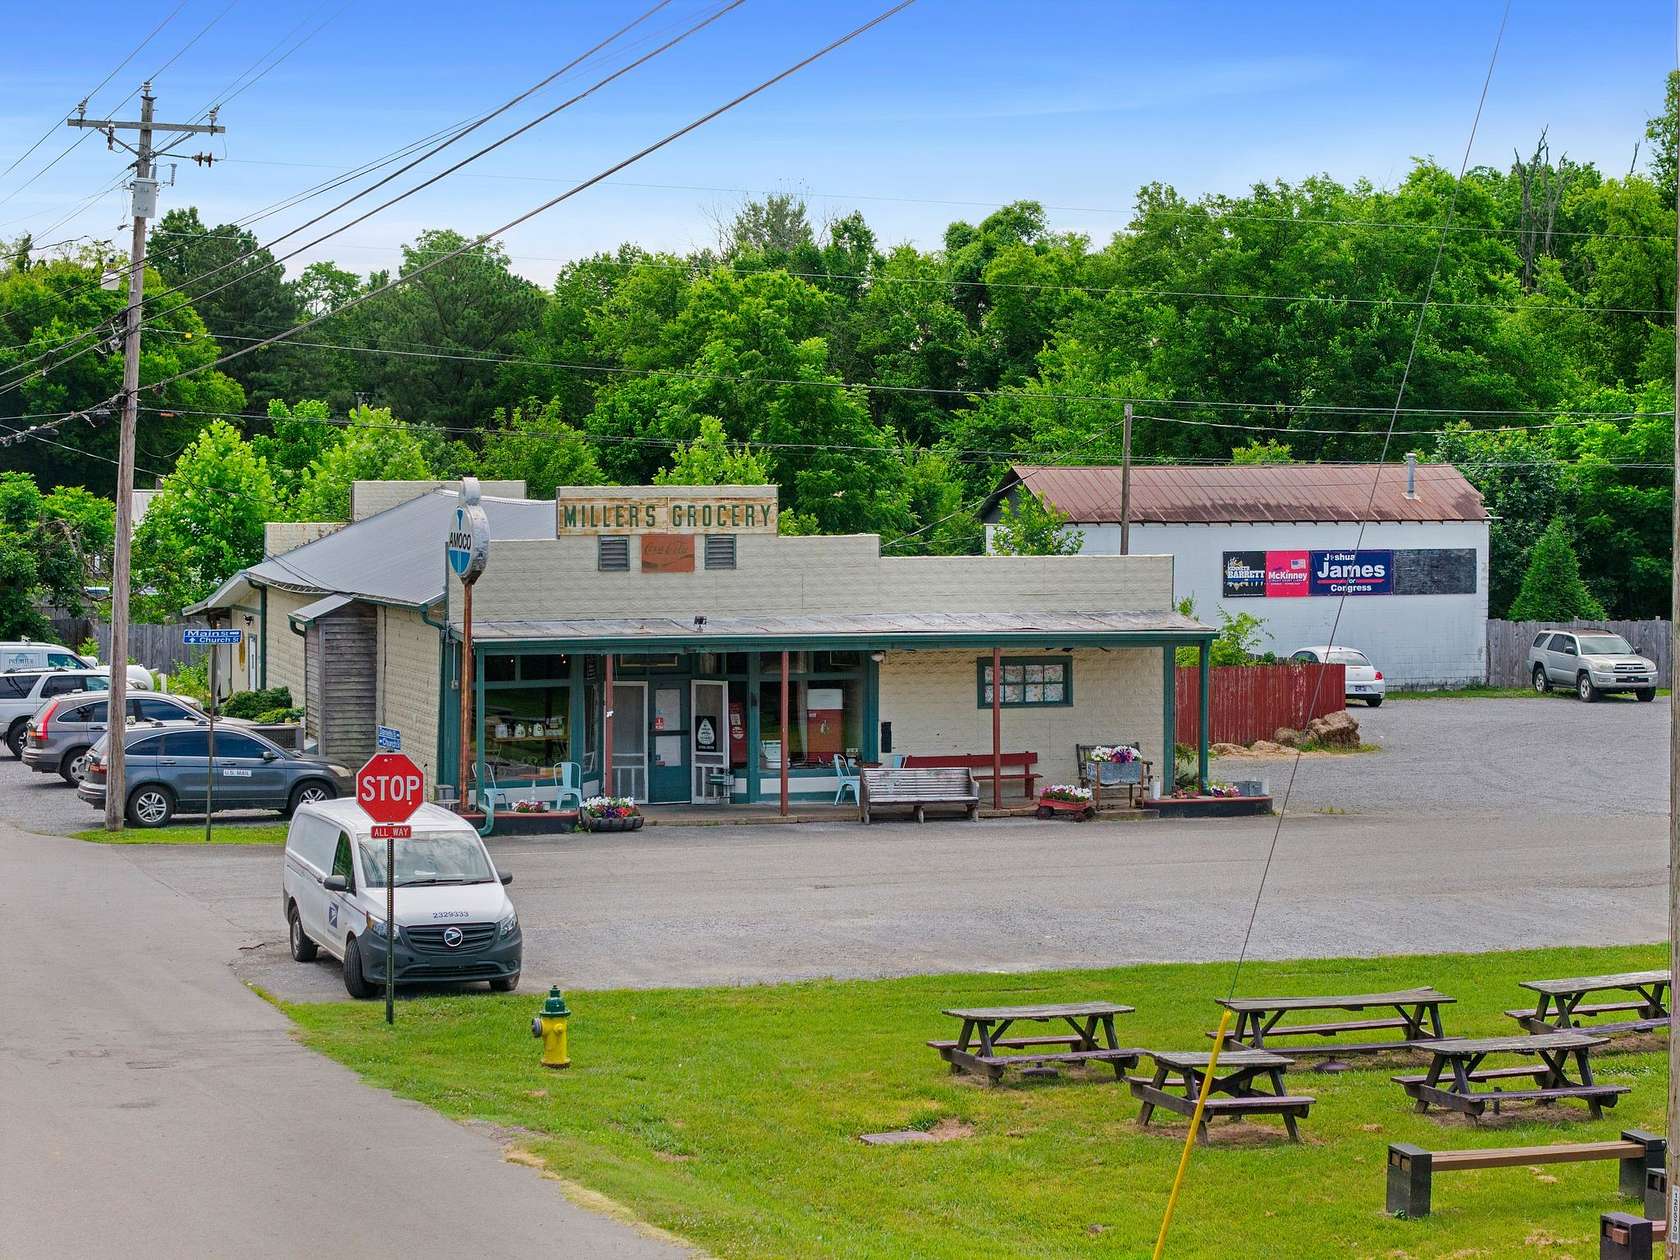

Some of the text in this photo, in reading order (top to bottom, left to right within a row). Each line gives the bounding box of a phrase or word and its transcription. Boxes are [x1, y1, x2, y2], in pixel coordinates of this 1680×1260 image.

[672, 505, 771, 526] GROCERY
[449, 532, 471, 550] AMOCO
[1227, 570, 1265, 579] BARRETT
[1268, 569, 1308, 581] McKinney
[1317, 562, 1386, 578] James
[1330, 584, 1373, 593] Congress
[361, 775, 420, 802] STOP
[374, 828, 409, 837] ALL WAY
